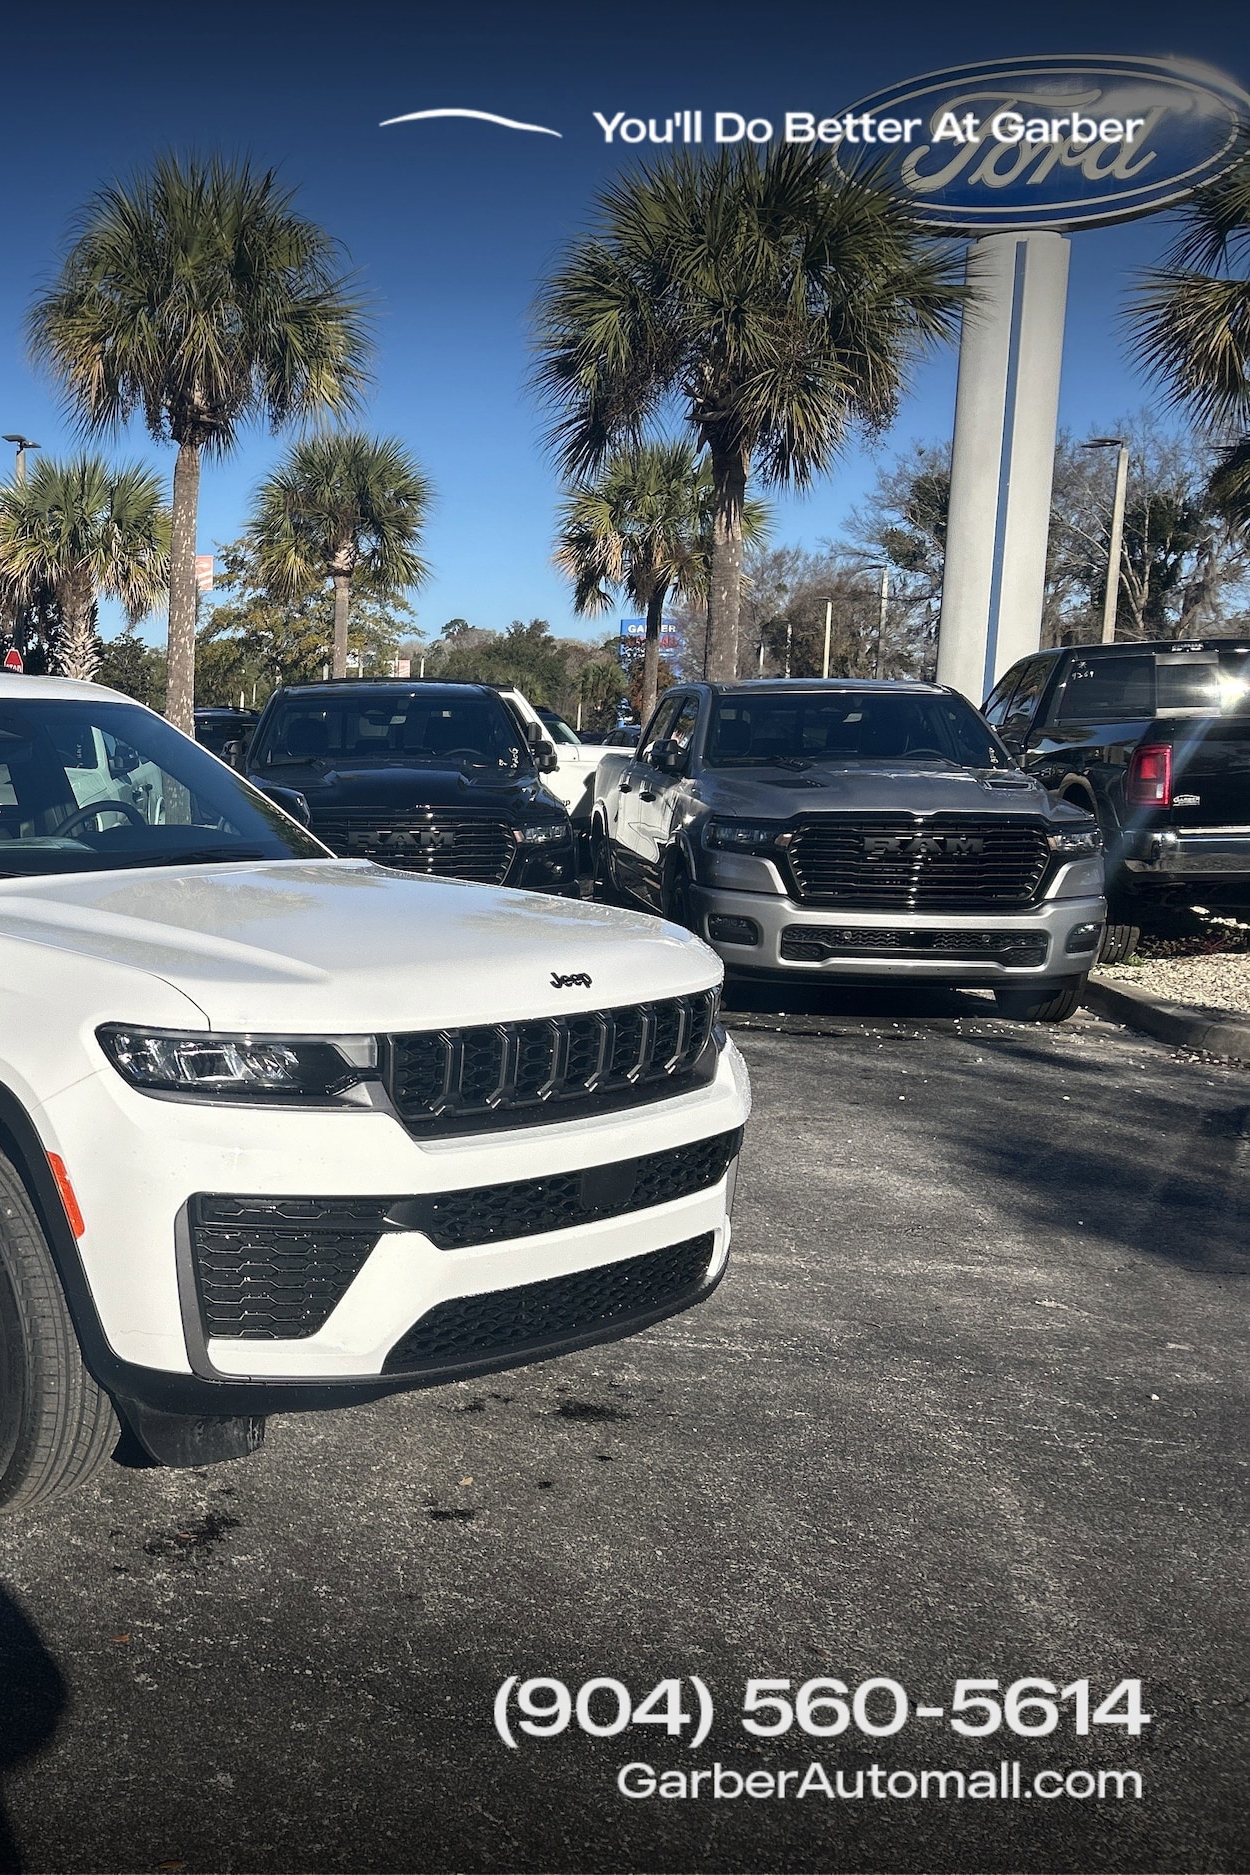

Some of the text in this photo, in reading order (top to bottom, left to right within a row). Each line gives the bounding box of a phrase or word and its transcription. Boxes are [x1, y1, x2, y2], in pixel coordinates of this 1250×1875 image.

[901, 89, 1169, 193] Ford
[627, 624, 677, 633] GAER
[347, 831, 455, 847] RAM
[863, 837, 984, 853] RAM
[549, 972, 593, 989] Jeep
